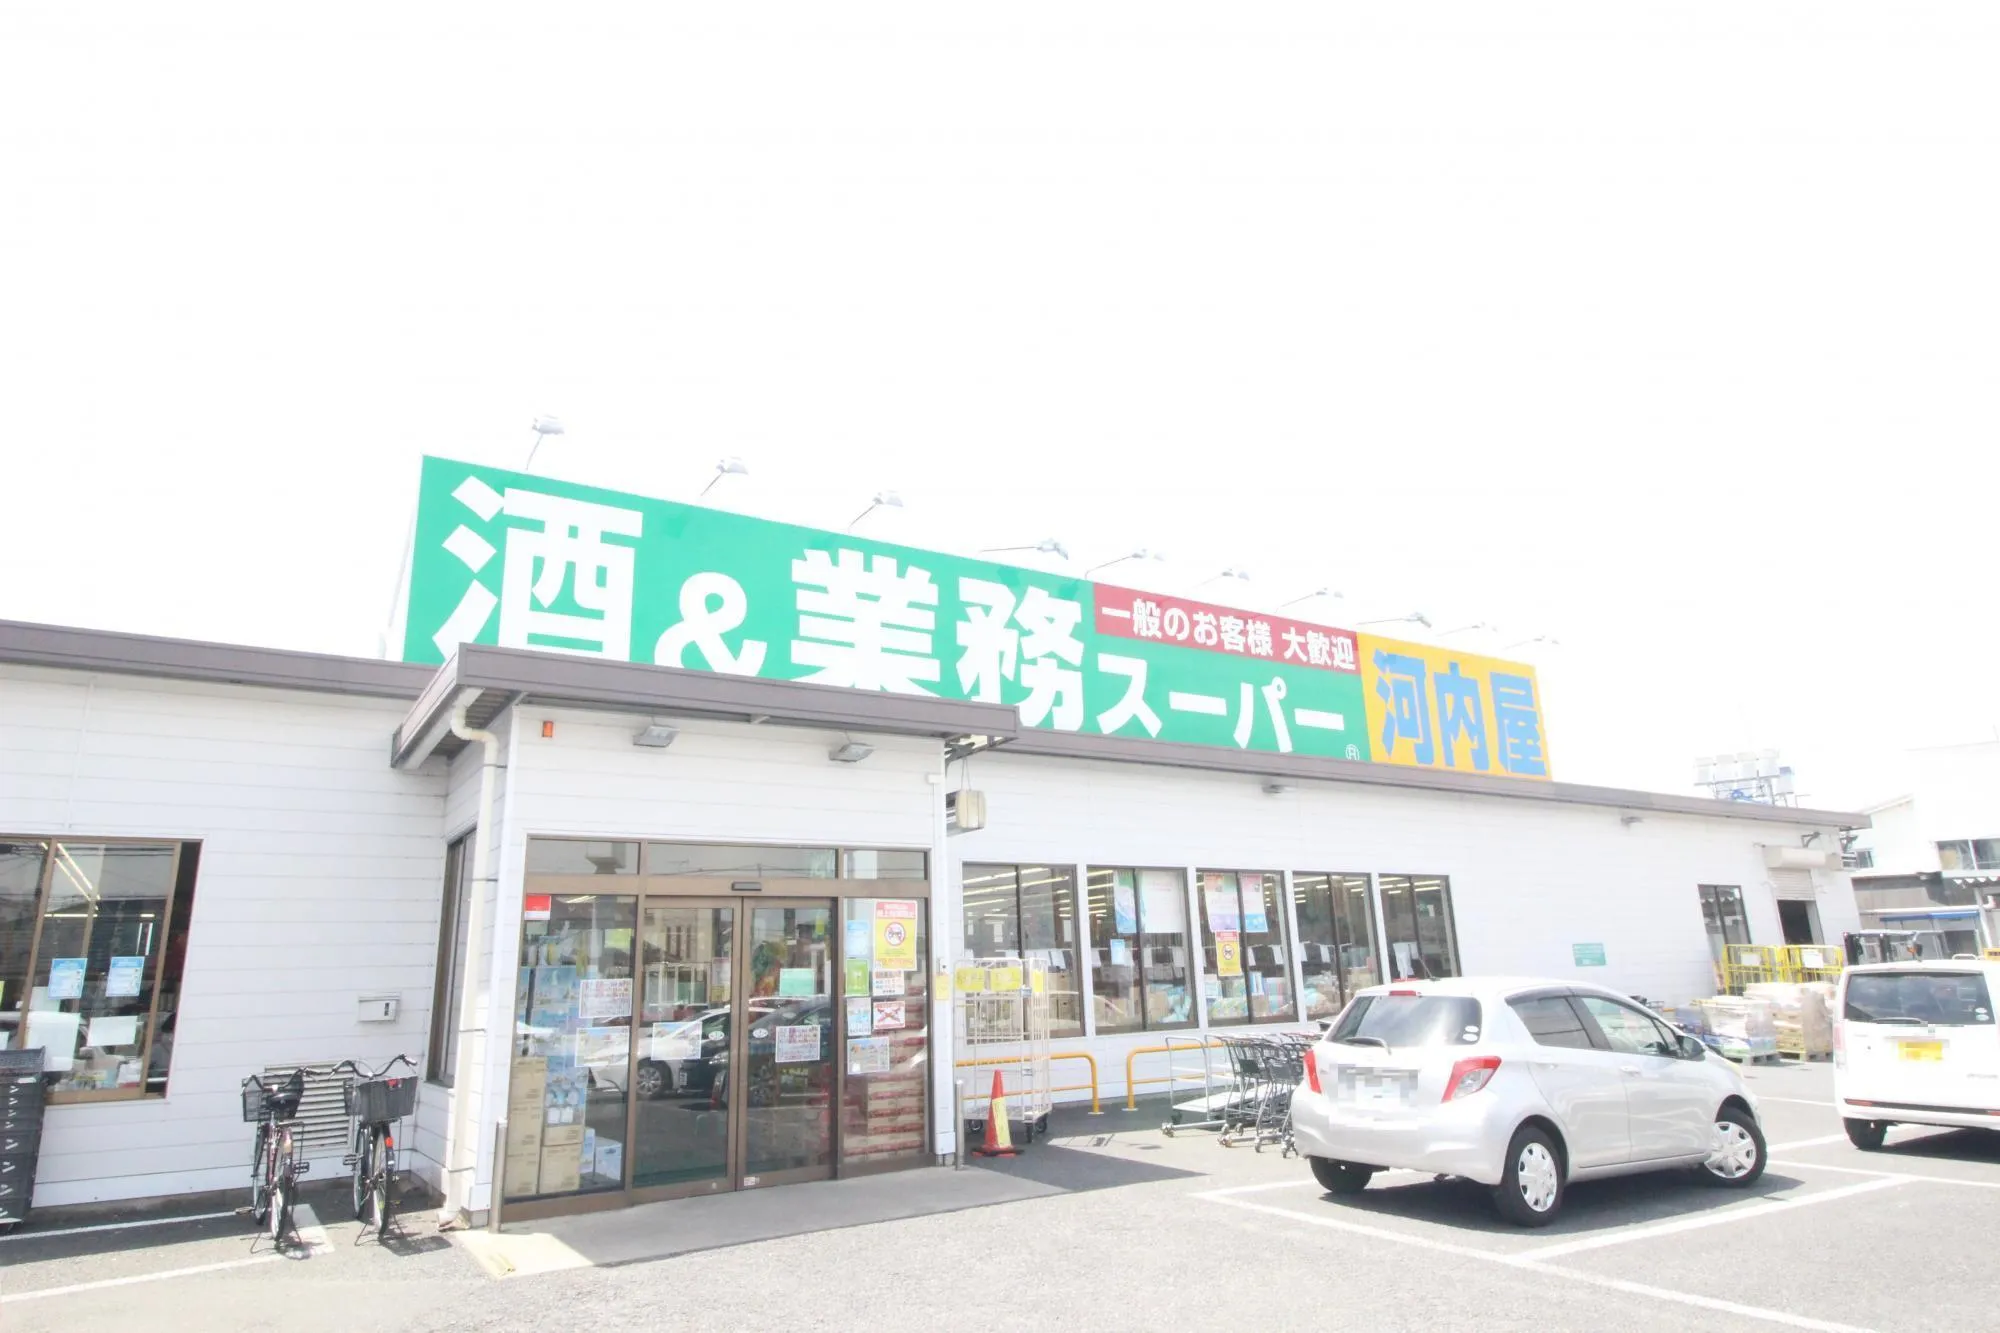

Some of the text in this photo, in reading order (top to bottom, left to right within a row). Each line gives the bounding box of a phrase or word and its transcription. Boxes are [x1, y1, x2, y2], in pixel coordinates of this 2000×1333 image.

[1102, 599, 1355, 670] 一般のお客様 大歓迎
[1373, 648, 1546, 776] 河内屋
